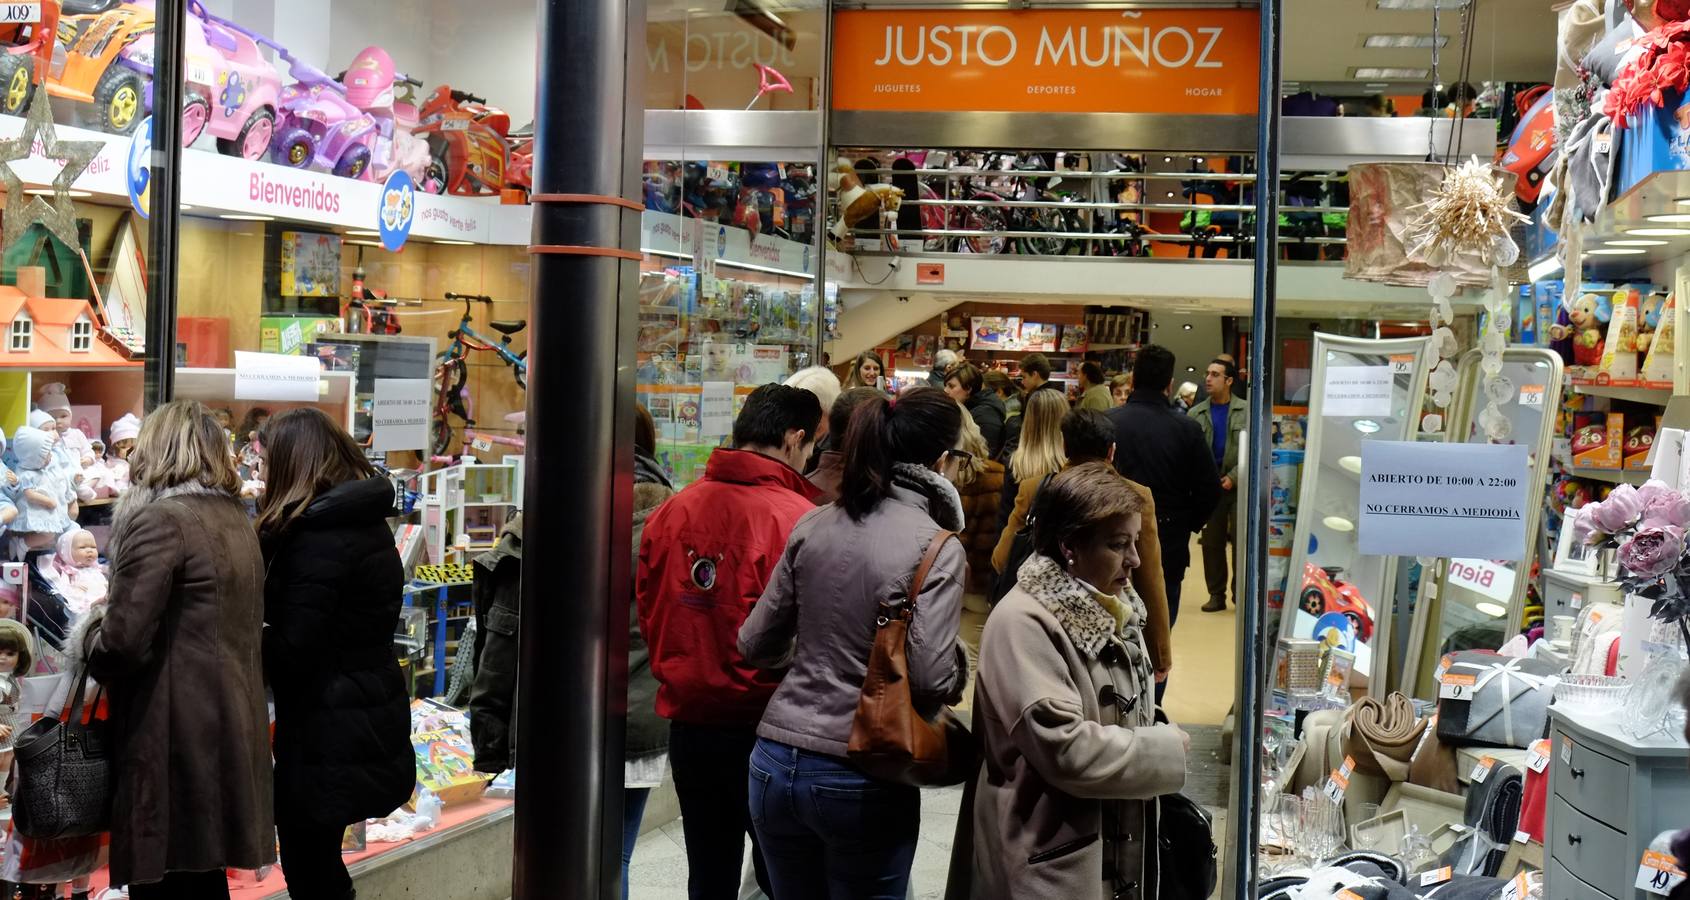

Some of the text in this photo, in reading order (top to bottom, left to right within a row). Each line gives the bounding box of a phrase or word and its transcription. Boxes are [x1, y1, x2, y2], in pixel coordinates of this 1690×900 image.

[874, 10, 1224, 69] JUSTO MUÑOZ
[873, 84, 921, 93] JUGUETES
[1026, 85, 1077, 95] DEPORTES
[1185, 87, 1223, 97] HOGAR
[249, 172, 340, 213] Bienvenidos
[1368, 473, 1517, 488] ABIERTO DE 10:00 A 22:00
[1366, 503, 1520, 518] NO CERRAMOS A MEDIODÍA
[1453, 684, 1463, 698] 9
